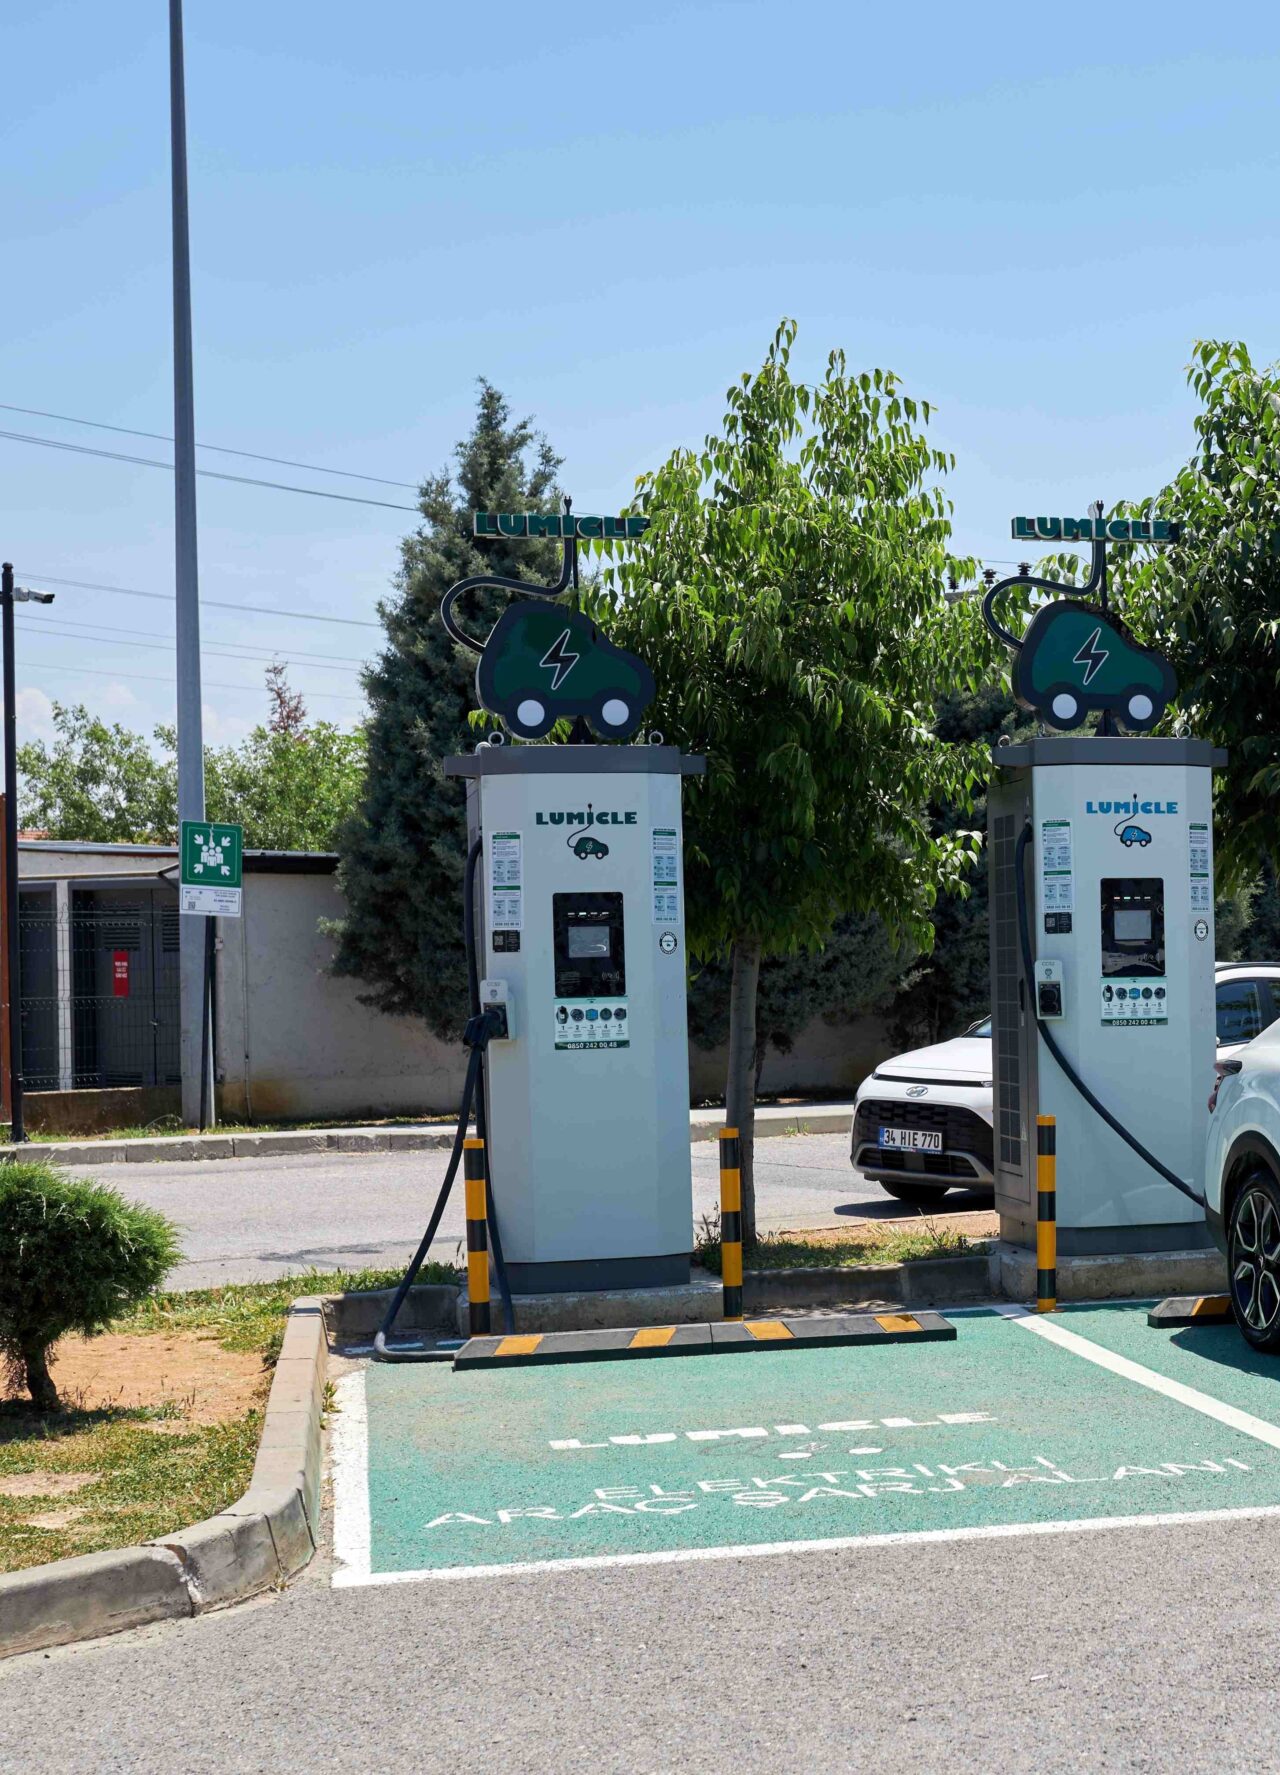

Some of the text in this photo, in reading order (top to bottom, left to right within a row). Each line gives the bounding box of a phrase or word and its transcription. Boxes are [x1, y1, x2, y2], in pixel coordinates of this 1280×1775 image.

[1086, 801, 1178, 815] LUMICLE
[536, 811, 637, 825] LUMICLE
[884, 1129, 940, 1148] 34 HIE 770
[548, 1411, 998, 1450] LUMICLE
[423, 1497, 699, 1529] ARAÇ
[1001, 1457, 1250, 1488] ALANI
